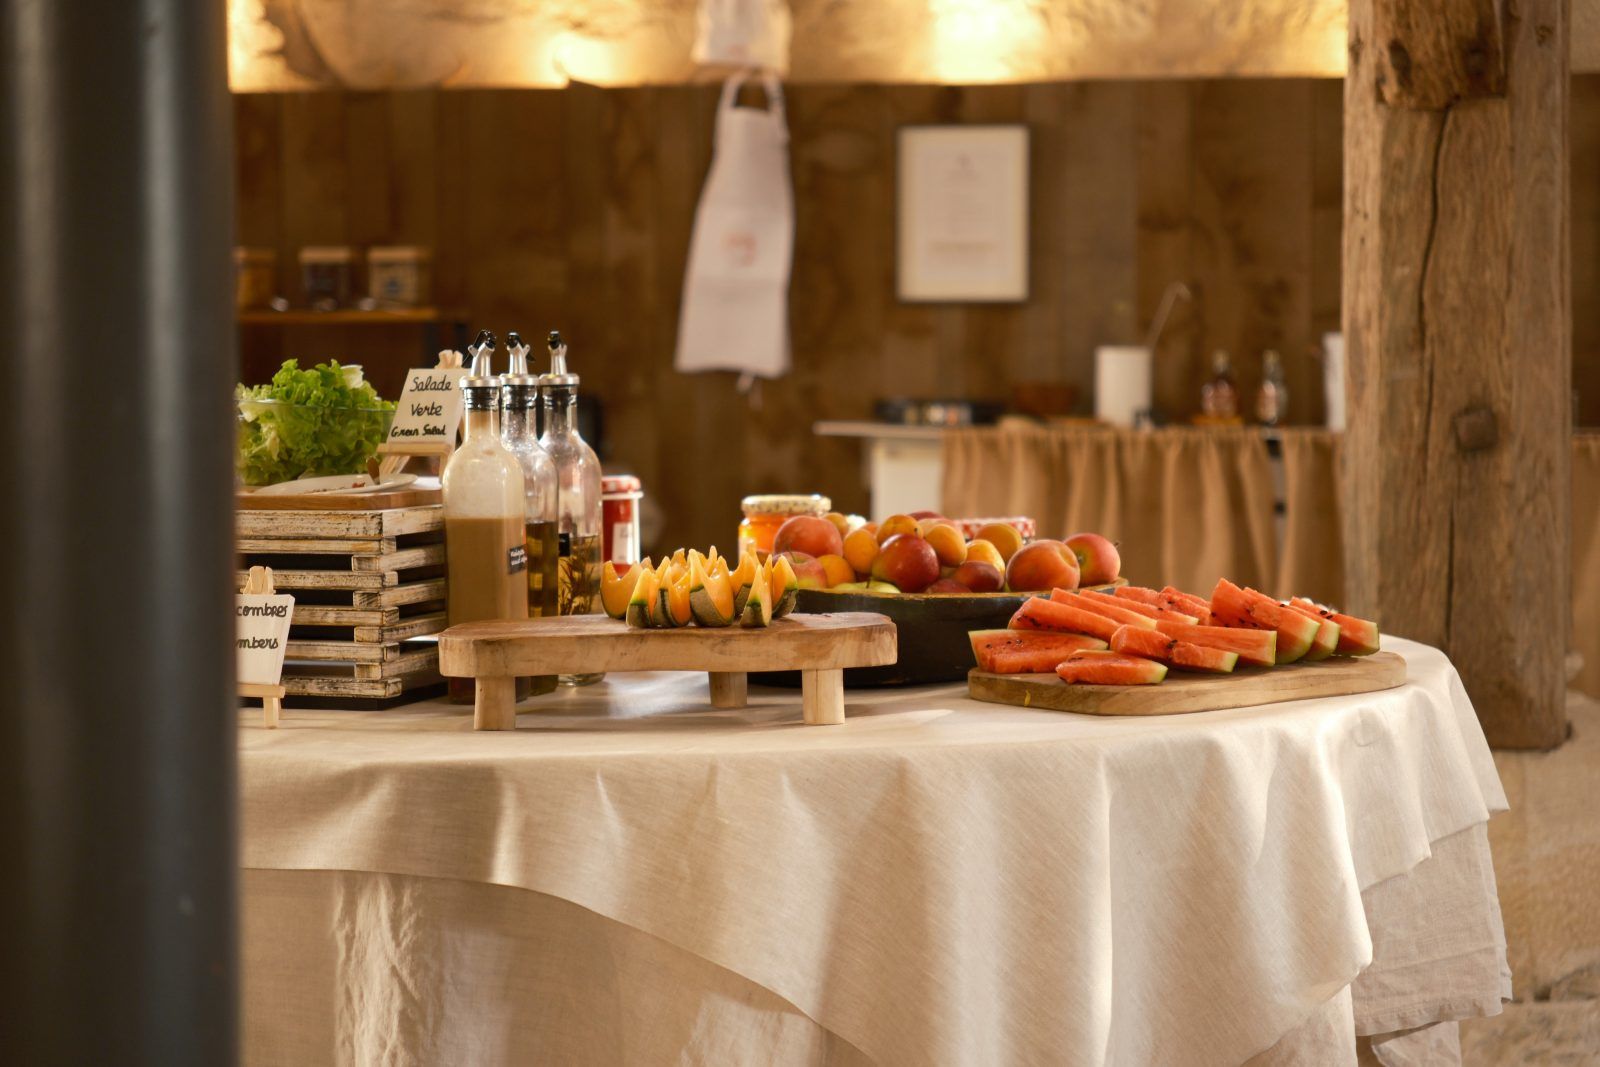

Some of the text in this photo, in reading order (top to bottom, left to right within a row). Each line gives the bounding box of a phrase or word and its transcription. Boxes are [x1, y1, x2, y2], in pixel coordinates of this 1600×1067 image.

[409, 374, 452, 393] Salade
[411, 401, 443, 417] Verte
[390, 423, 447, 438] Green Salad
